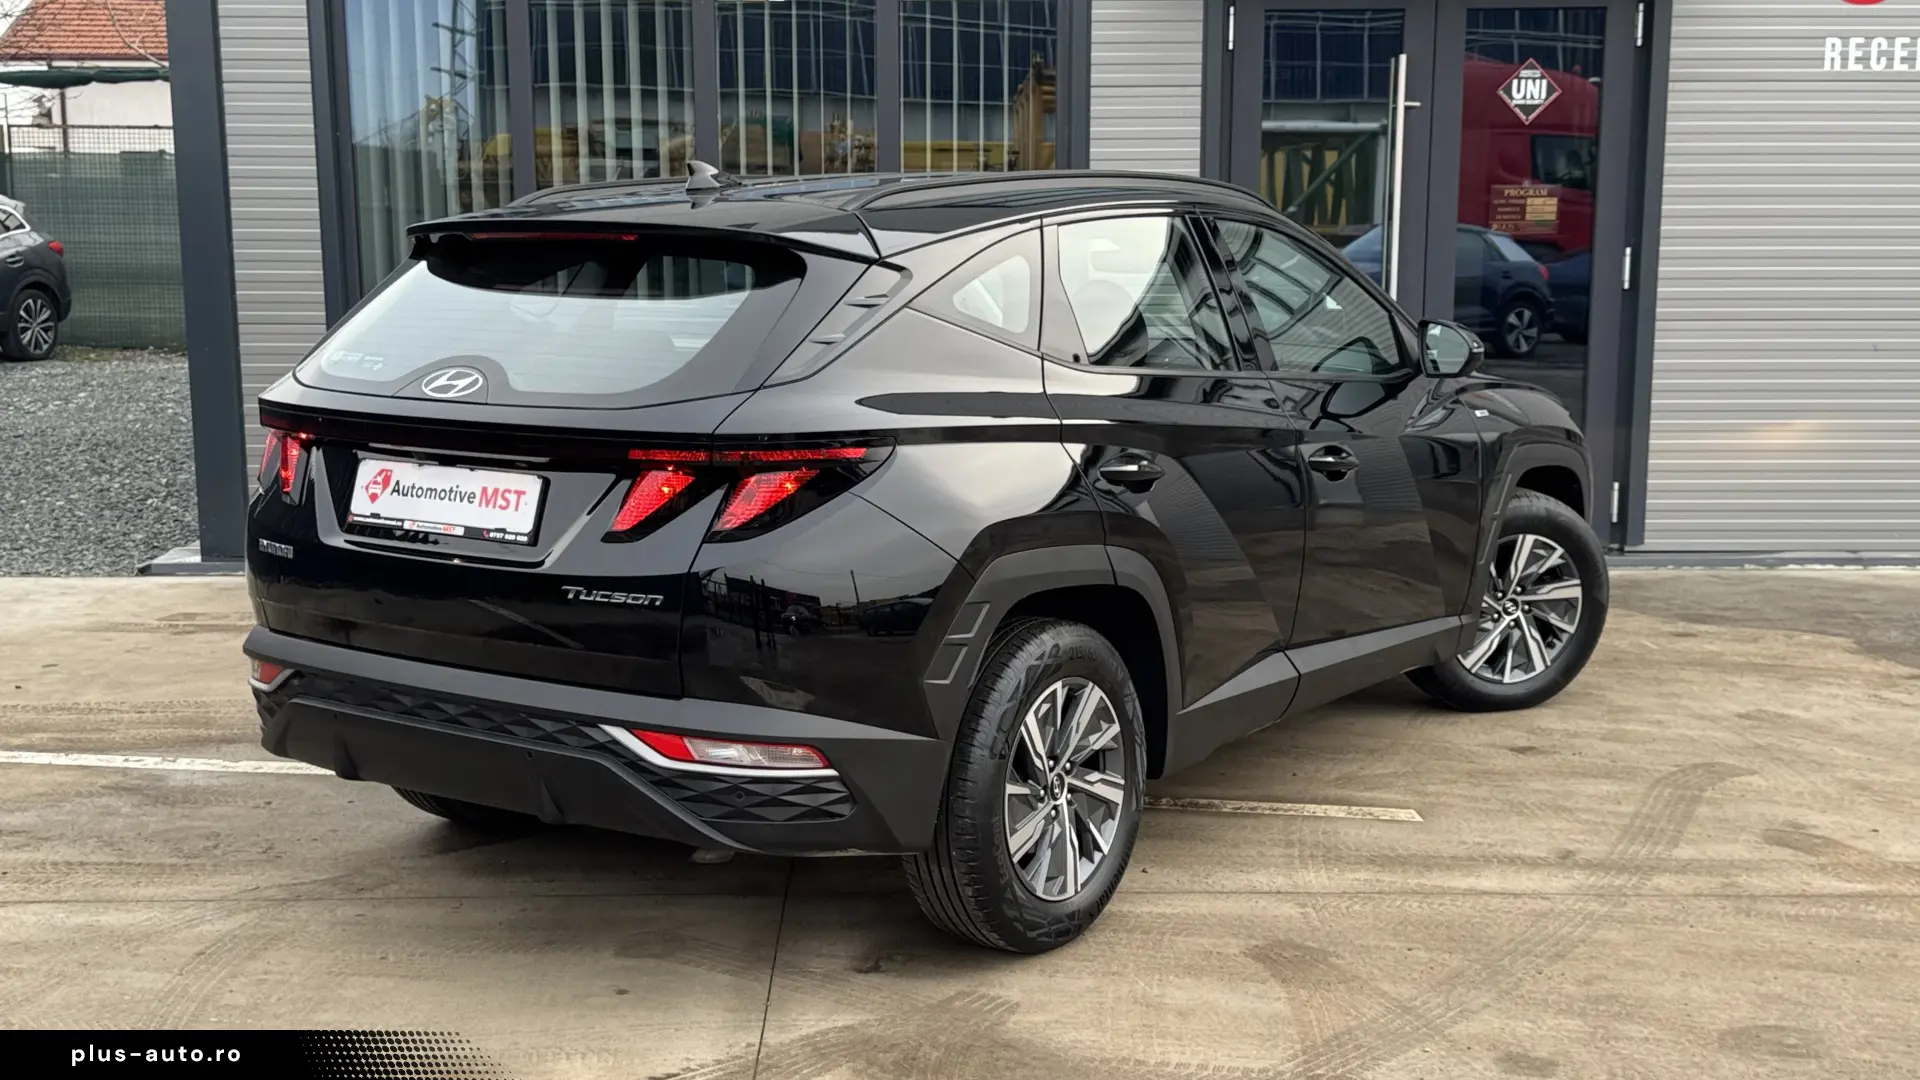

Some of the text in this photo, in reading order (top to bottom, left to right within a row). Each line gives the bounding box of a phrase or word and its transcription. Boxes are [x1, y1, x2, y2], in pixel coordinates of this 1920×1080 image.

[1823, 36, 1920, 71] RECE
[1511, 78, 1548, 100] UNI
[1503, 188, 1549, 197] PROGRAM
[390, 479, 527, 512] Automotive MST
